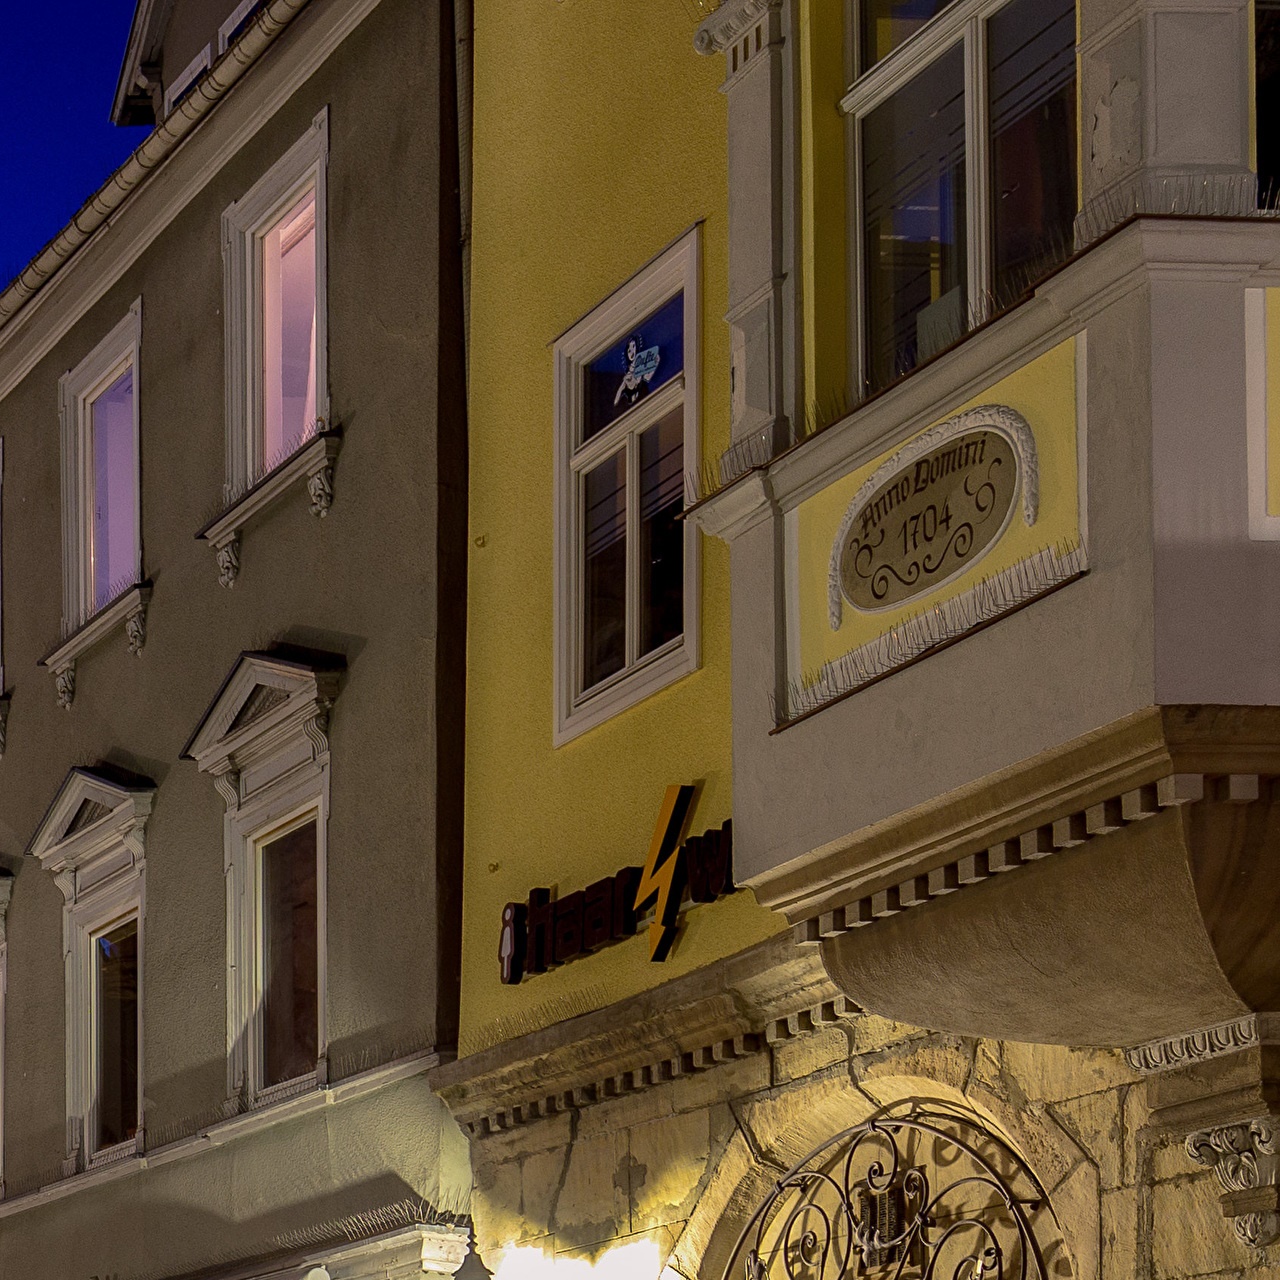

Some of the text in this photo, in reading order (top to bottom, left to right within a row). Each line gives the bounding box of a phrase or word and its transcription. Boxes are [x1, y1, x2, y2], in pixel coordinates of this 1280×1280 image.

[859, 432, 988, 540] Anno Domini
[897, 495, 953, 556] 1704
